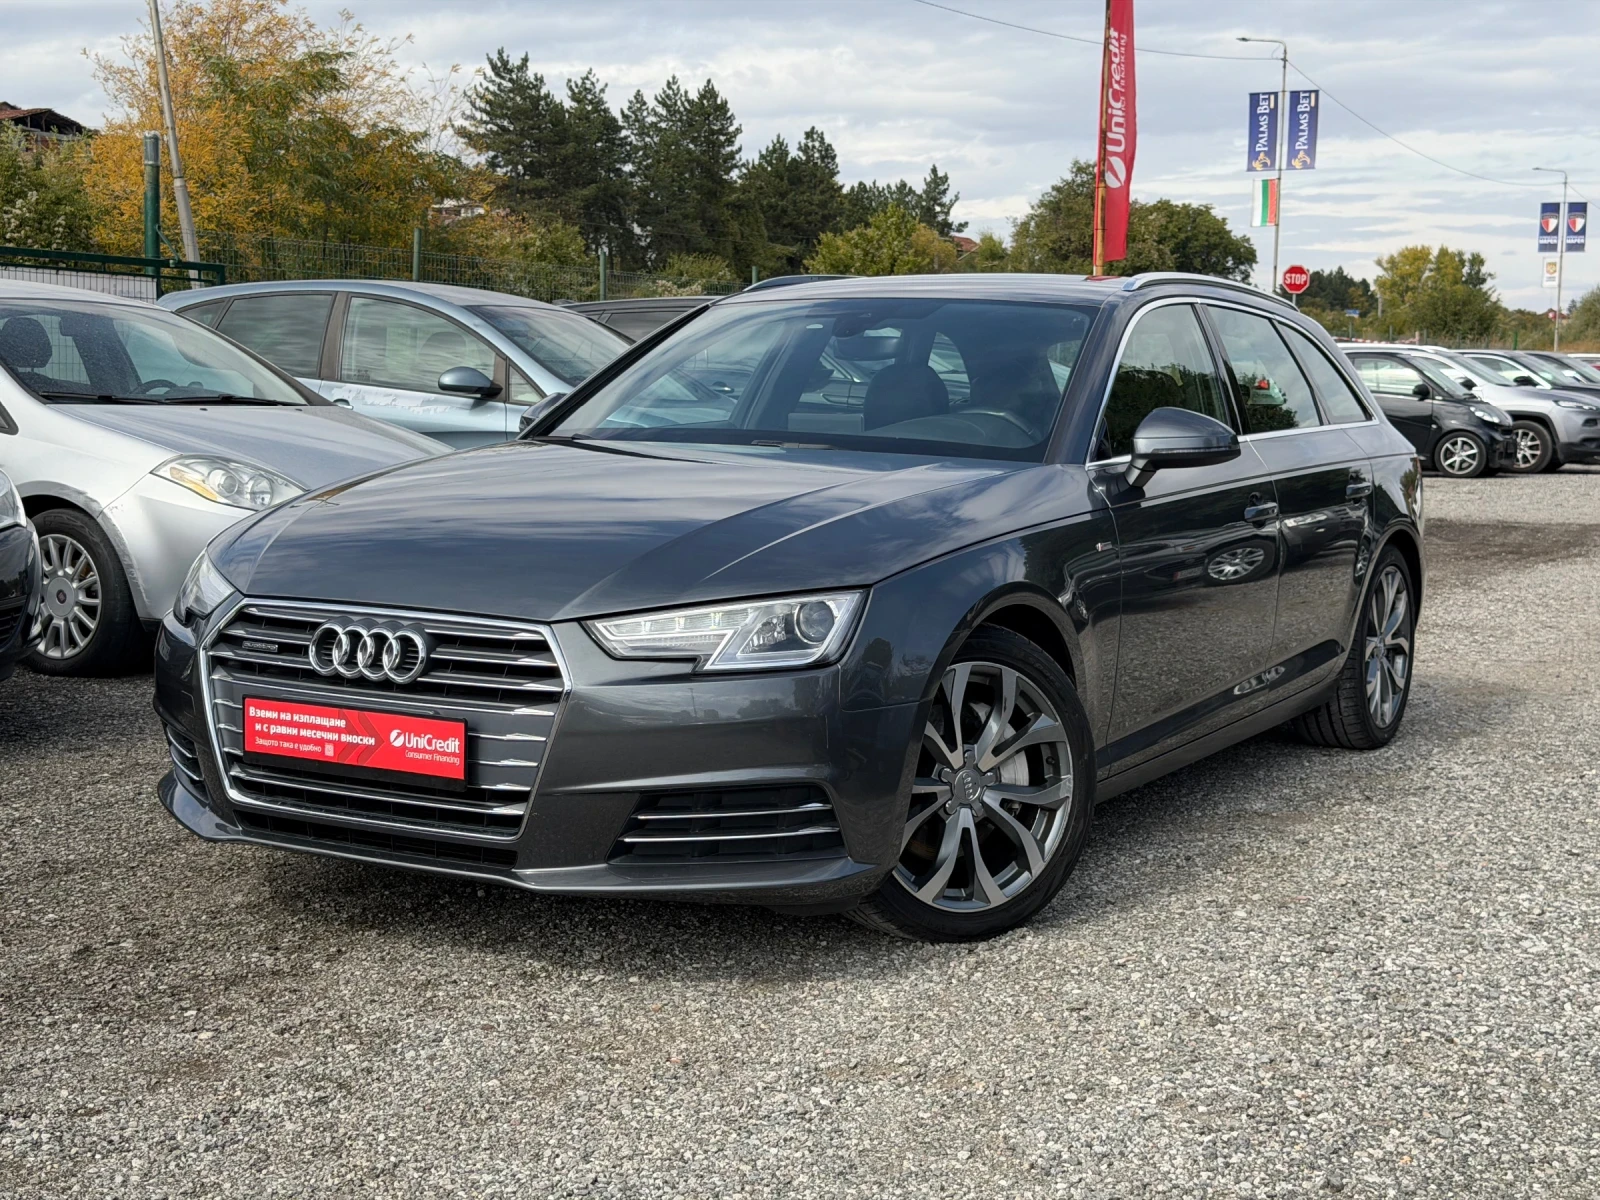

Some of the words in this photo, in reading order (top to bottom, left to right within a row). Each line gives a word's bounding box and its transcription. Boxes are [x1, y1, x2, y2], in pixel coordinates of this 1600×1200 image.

[1106, 28, 1126, 153] UniCredit
[1257, 93, 1270, 114] BET
[1297, 92, 1310, 112] BET
[1256, 115, 1269, 152] PALMS
[1295, 113, 1309, 150] PALMS
[1284, 273, 1307, 285] STOP
[249, 706, 278, 719] Вземи
[280, 712, 291, 721] на
[293, 714, 346, 728] изплащане
[255, 723, 261, 731] и
[263, 724, 269, 732] с
[270, 724, 298, 735] равни
[300, 728, 339, 741] месечни
[341, 733, 375, 746] вноски
[255, 736, 279, 747] Защото
[279, 741, 294, 749] така
[299, 743, 322, 752] удобно
[405, 732, 460, 753] UniCredit
[405, 749, 433, 761] Consumer
[433, 754, 460, 766] Financing
